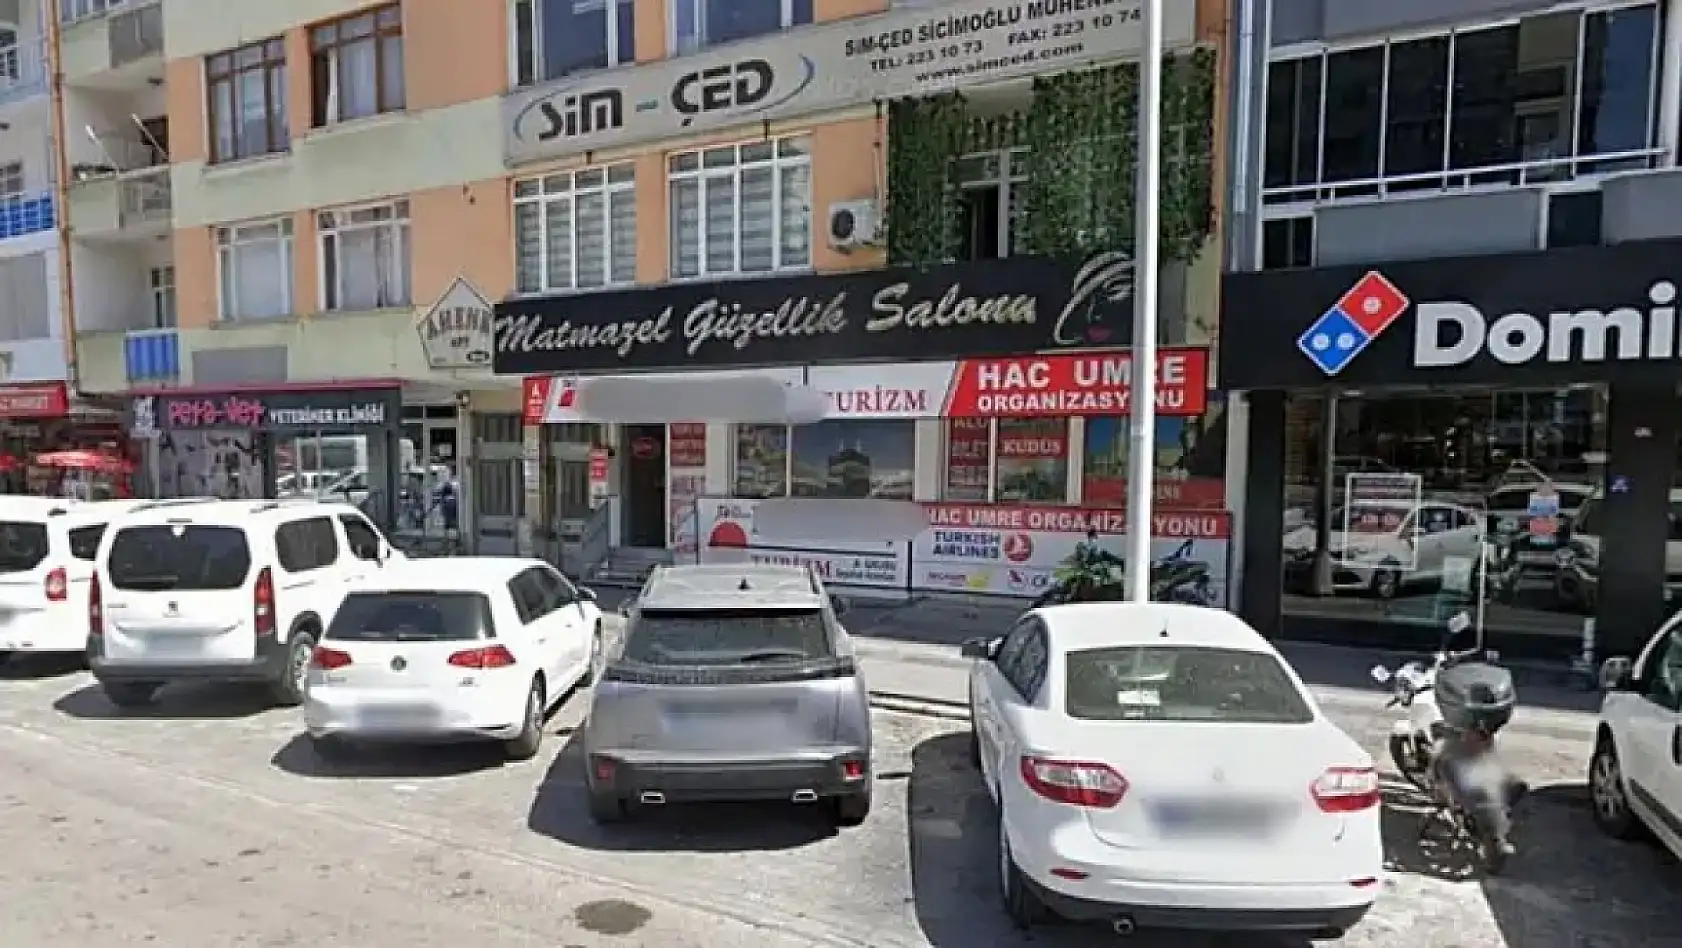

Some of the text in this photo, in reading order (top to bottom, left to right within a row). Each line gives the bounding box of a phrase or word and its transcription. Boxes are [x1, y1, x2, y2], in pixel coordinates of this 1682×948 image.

[1092, 13, 1113, 29] 10
[671, 58, 774, 127] ÇED
[495, 282, 1037, 358] Matmazel Güzellik Salonu
[1413, 280, 1682, 367] Domi
[977, 355, 1187, 392] HAC UME
[824, 384, 927, 412] URİZM
[978, 388, 1184, 414] ORGANİZASYNU
[967, 508, 1022, 527] UMRE
